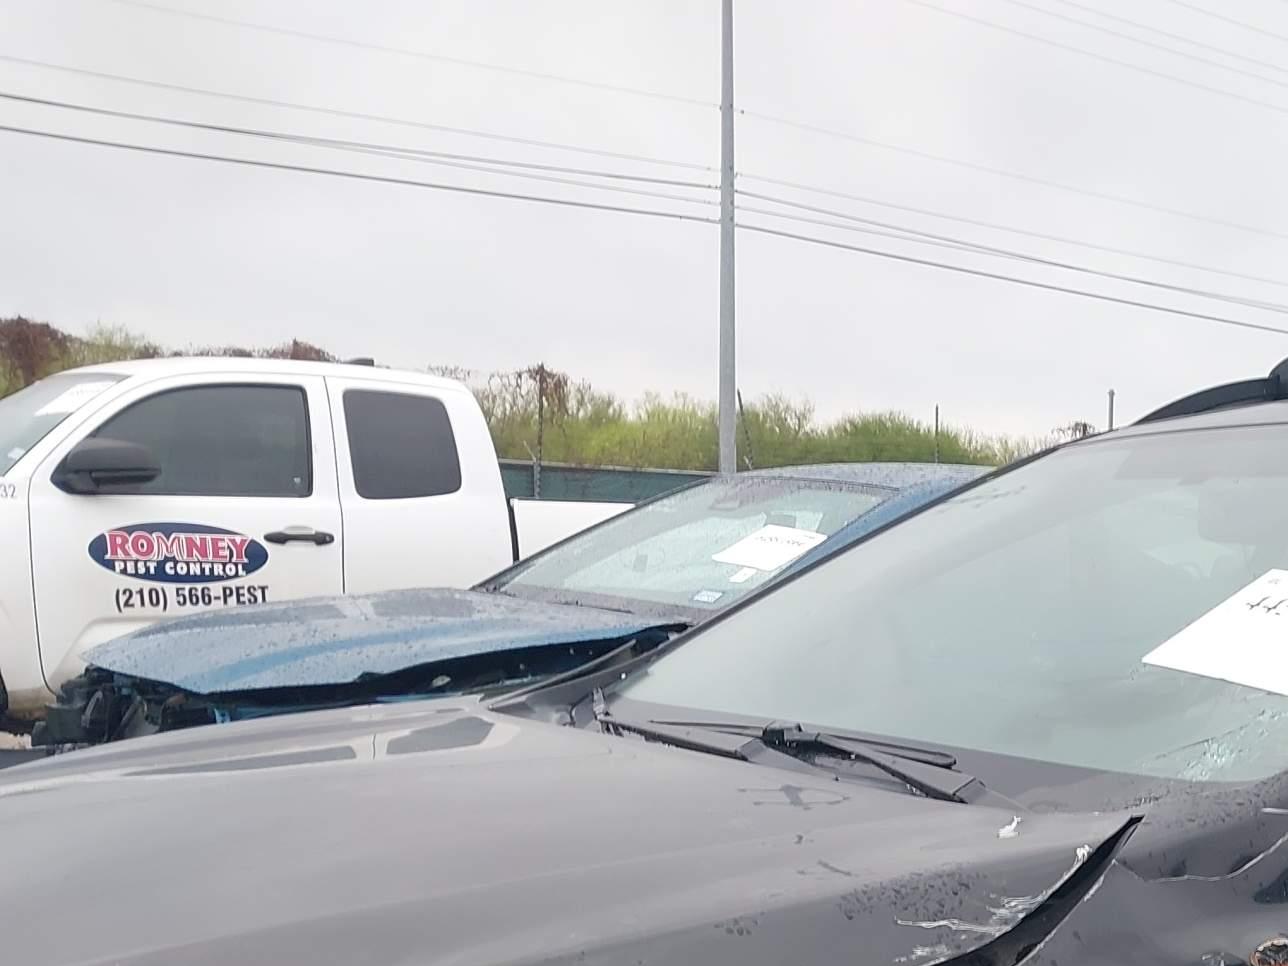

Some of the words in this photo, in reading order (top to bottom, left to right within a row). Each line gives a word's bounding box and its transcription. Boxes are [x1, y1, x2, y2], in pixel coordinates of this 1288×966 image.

[105, 531, 250, 563] ROMNEY
[115, 562, 158, 575] PEST
[165, 563, 247, 577] CONTROL
[115, 587, 168, 612] (210)
[175, 585, 269, 607] 566-PEST
